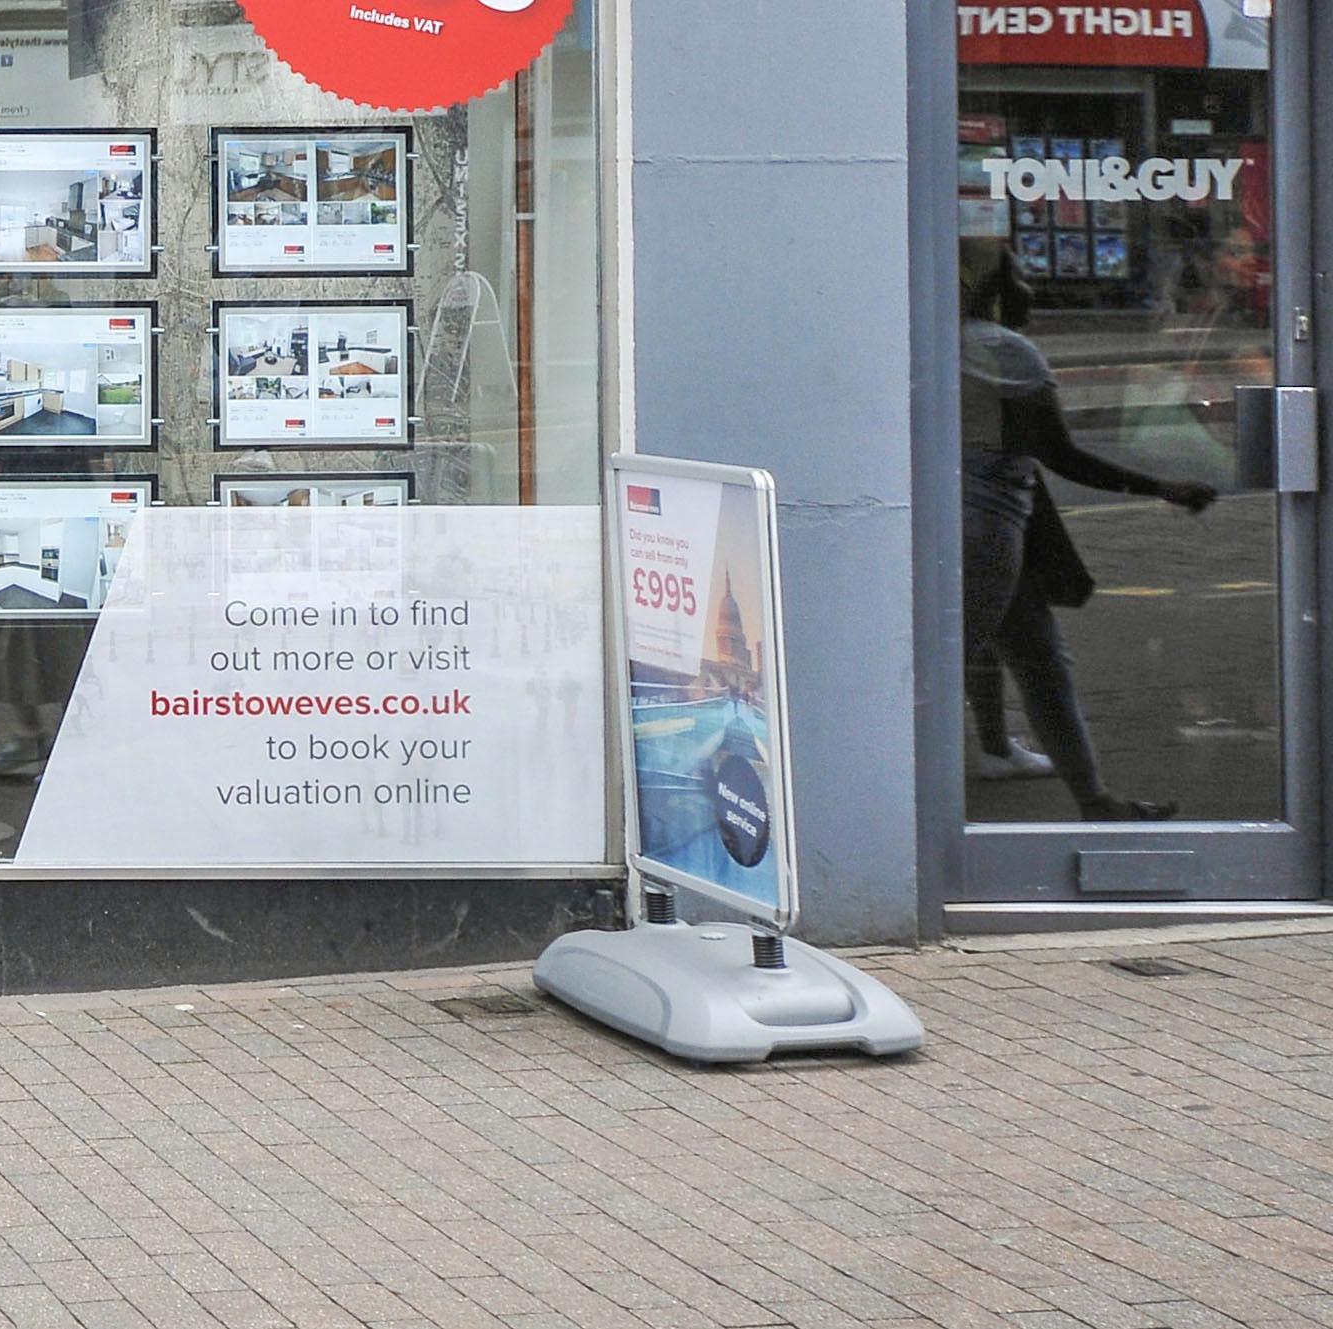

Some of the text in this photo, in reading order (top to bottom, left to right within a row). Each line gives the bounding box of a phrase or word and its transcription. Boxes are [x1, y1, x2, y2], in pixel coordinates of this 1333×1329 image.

[350, 5, 444, 35] Includes VAT
[983, 156, 1243, 202] TONI&GUY
[633, 568, 696, 615] £995
[225, 600, 469, 626] Come in to find
[210, 645, 471, 671] out more or visit
[150, 689, 471, 716] bairstoweves.co.uk
[266, 734, 471, 765] to book your
[217, 779, 471, 804] valuation online
[718, 781, 767, 822] New online
